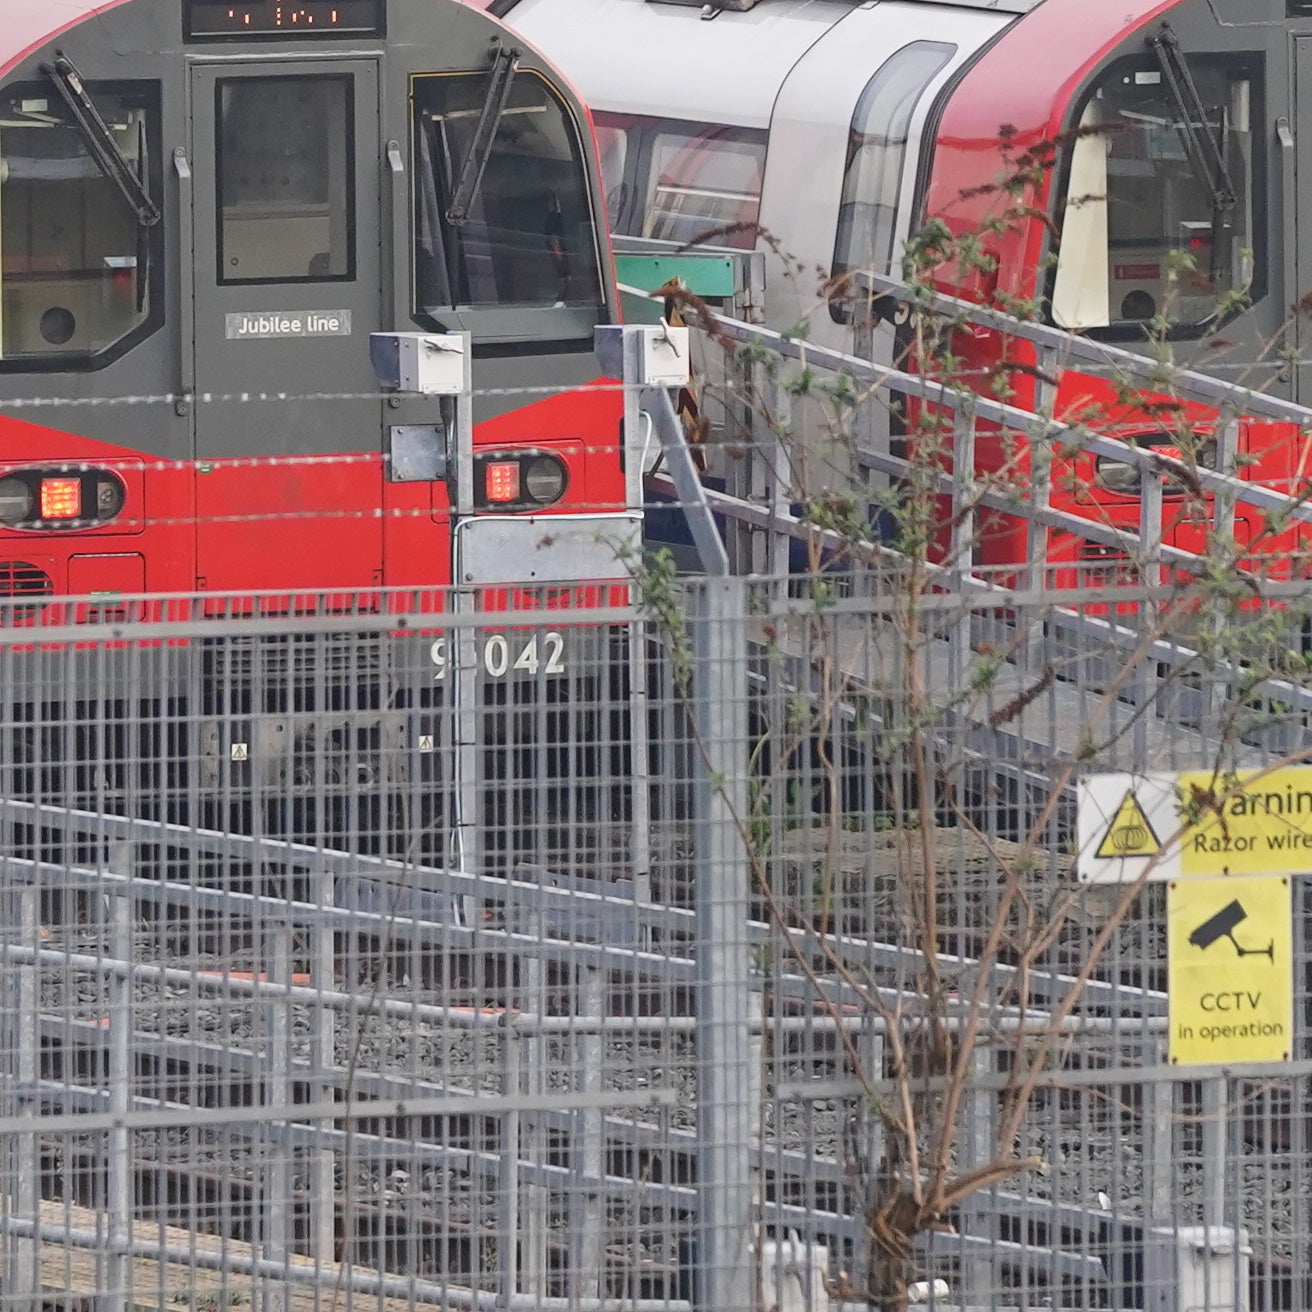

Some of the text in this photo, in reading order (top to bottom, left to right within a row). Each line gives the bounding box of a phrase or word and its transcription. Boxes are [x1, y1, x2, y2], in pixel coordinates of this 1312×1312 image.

[239, 315, 340, 334] Jubilee line
[430, 631, 565, 680] 9042
[1194, 833, 1257, 853] Razor
[1200, 992, 1261, 1012] CCTV
[1199, 1020, 1283, 1042] operation
